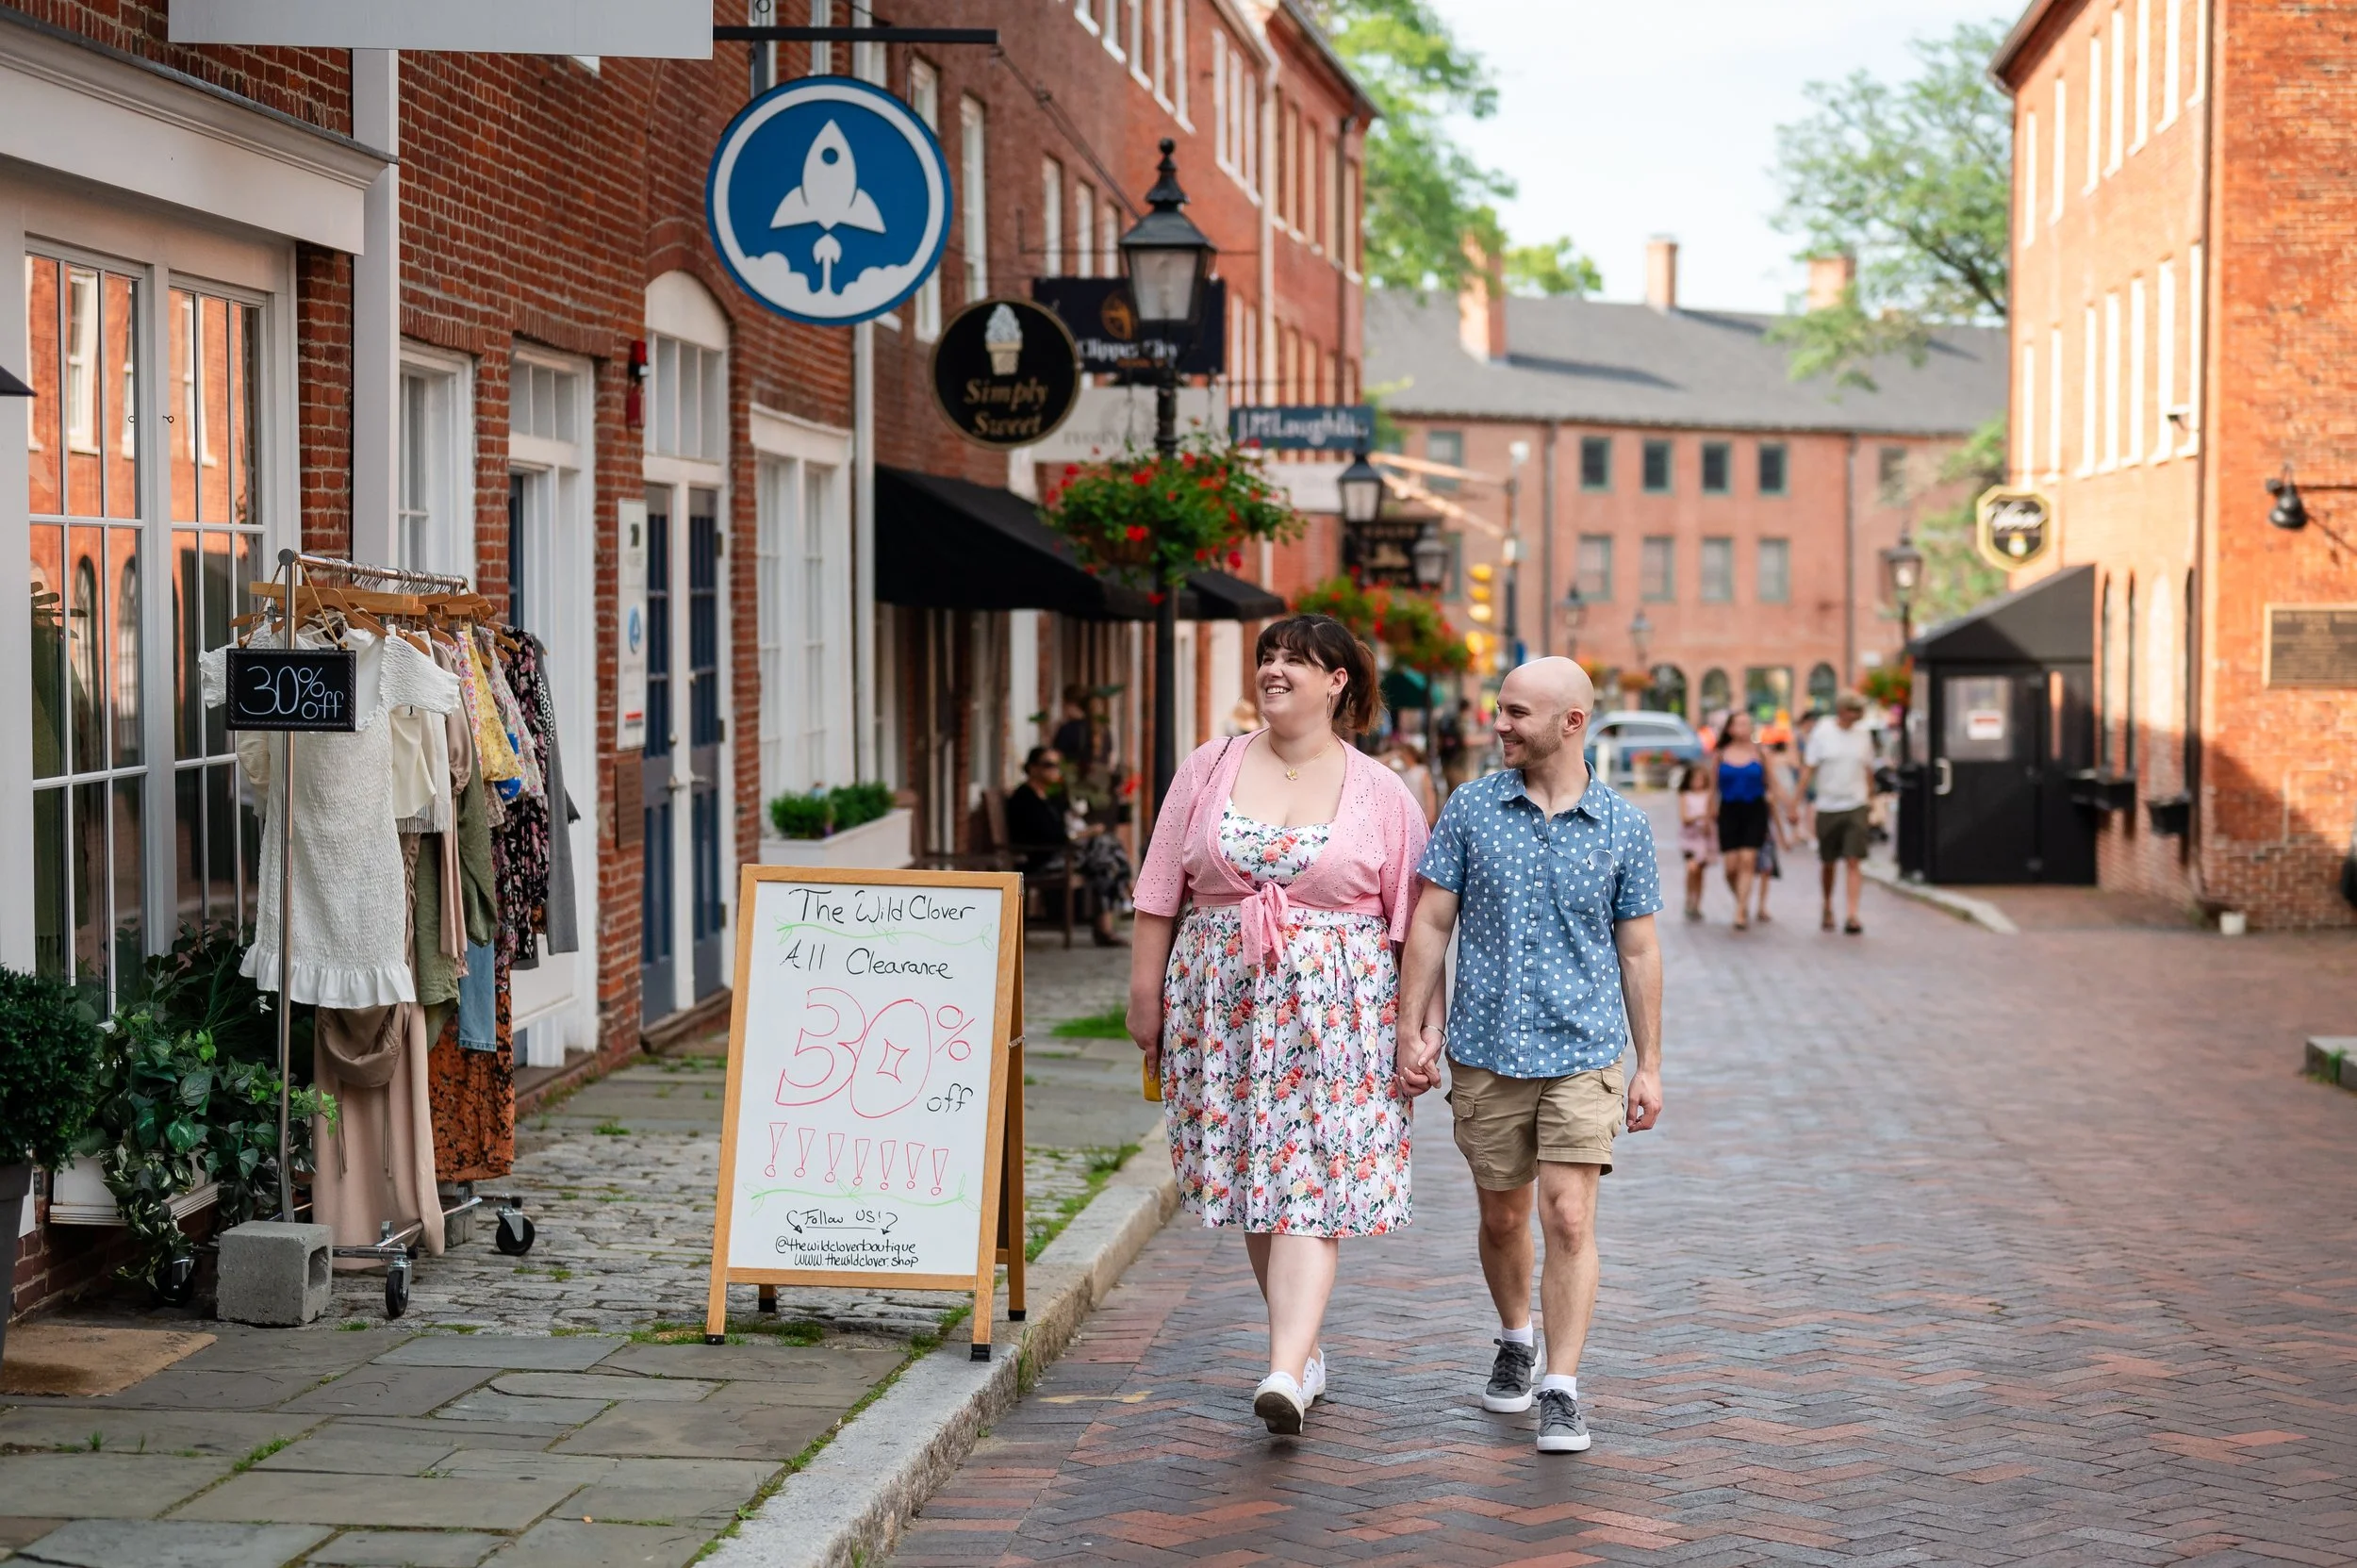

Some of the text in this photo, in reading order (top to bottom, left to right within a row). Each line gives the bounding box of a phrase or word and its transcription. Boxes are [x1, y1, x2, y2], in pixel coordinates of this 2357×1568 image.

[964, 378, 1048, 412] Simply
[972, 411, 1042, 436] Sweet
[239, 666, 325, 716] 30%
[302, 691, 344, 719] off
[788, 888, 976, 924] The Wild Clover
[780, 939, 954, 979] All Clearance
[775, 986, 976, 1119] 30%
[926, 1082, 974, 1114] off
[799, 1208, 844, 1226] Follow
[775, 1235, 916, 1258] @thewildcloverboutique
